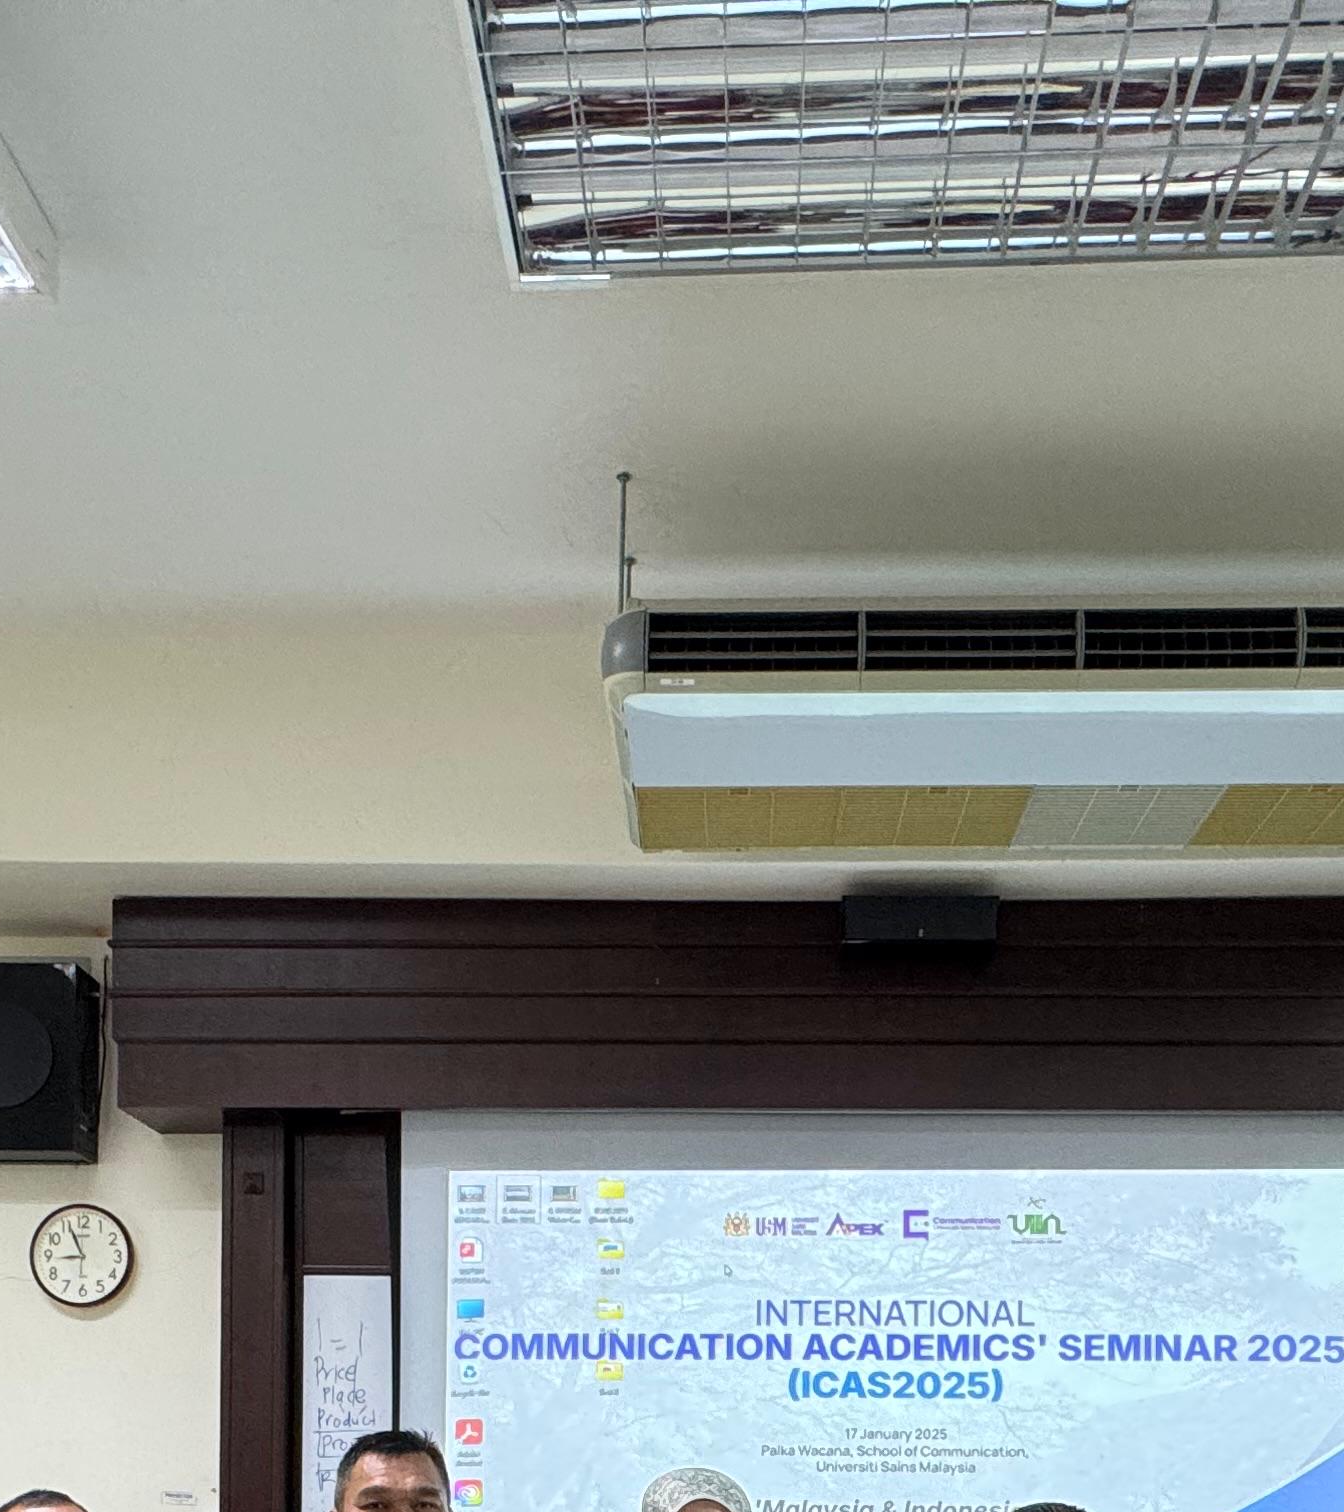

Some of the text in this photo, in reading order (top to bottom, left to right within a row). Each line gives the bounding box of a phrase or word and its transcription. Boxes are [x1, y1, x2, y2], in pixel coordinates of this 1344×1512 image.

[77, 1215, 90, 1229] 12
[98, 1219, 103, 1233] 1
[756, 1217, 786, 1236] USM
[48, 1232, 61, 1246] 10
[108, 1232, 118, 1246] 2
[44, 1249, 53, 1263] 9
[113, 1249, 122, 1264] 3
[48, 1266, 58, 1281] 8
[108, 1267, 117, 1280] 4
[60, 1280, 71, 1295] 7
[78, 1284, 88, 1298] 6
[95, 1279, 105, 1293] 5
[755, 1299, 1036, 1328] INTERNATIONAL
[454, 1332, 792, 1361] COMMUNICATION
[803, 1332, 1047, 1362] ACADEMICS'
[1058, 1333, 1238, 1362] SEMINAR
[788, 1367, 1003, 1402] (ICAS2025)
[845, 1428, 948, 1443] 17 January 2025
[322, 1434, 355, 1457] Pro
[797, 1445, 854, 1458] Wacana,
[856, 1445, 903, 1457] School
[904, 1445, 918, 1457] of
[919, 1445, 1030, 1459] Communication,
[815, 1461, 977, 1476] Universiti Sains Malaysia
